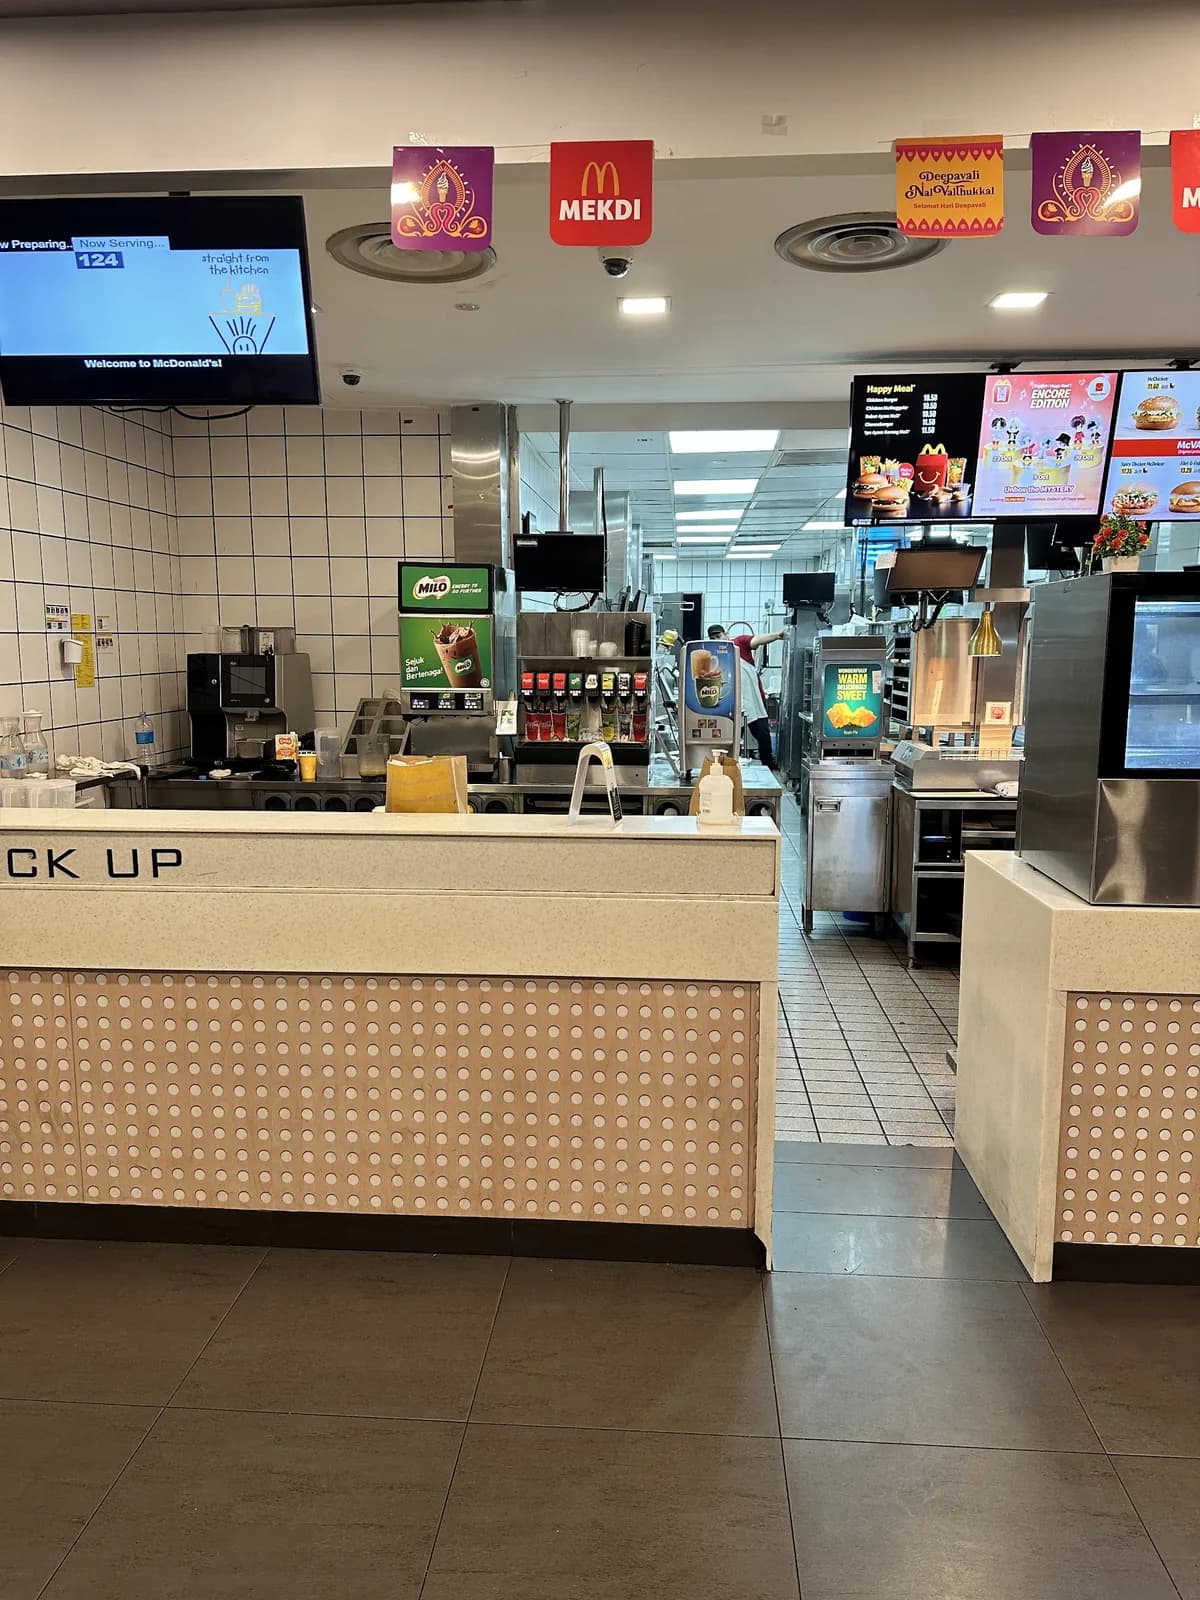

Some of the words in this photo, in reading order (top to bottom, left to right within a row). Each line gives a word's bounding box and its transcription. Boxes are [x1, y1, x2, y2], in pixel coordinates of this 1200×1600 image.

[918, 170, 980, 184] Deepavali
[905, 182, 933, 199] Nal
[559, 198, 641, 221] MEKDI
[80, 239, 106, 248] Now
[109, 238, 165, 248] Serving...
[79, 253, 119, 267] 124
[201, 252, 243, 264] straight
[246, 253, 270, 263] from
[209, 264, 228, 275] the
[230, 264, 269, 275] kitchen
[84, 359, 137, 369] Welcome
[138, 359, 151, 368] to
[153, 358, 223, 368] McDonald's!
[866, 385, 893, 395] Happy
[1031, 389, 1072, 399] ENCORE
[1029, 399, 1070, 409] EDITION
[418, 582, 447, 594] MILO
[405, 657, 425, 666] Sejuk
[406, 666, 443, 680] Bertenaga!
[838, 673, 868, 684] WARM
[837, 690, 867, 700] SWEET
[106, 848, 183, 878] UP
